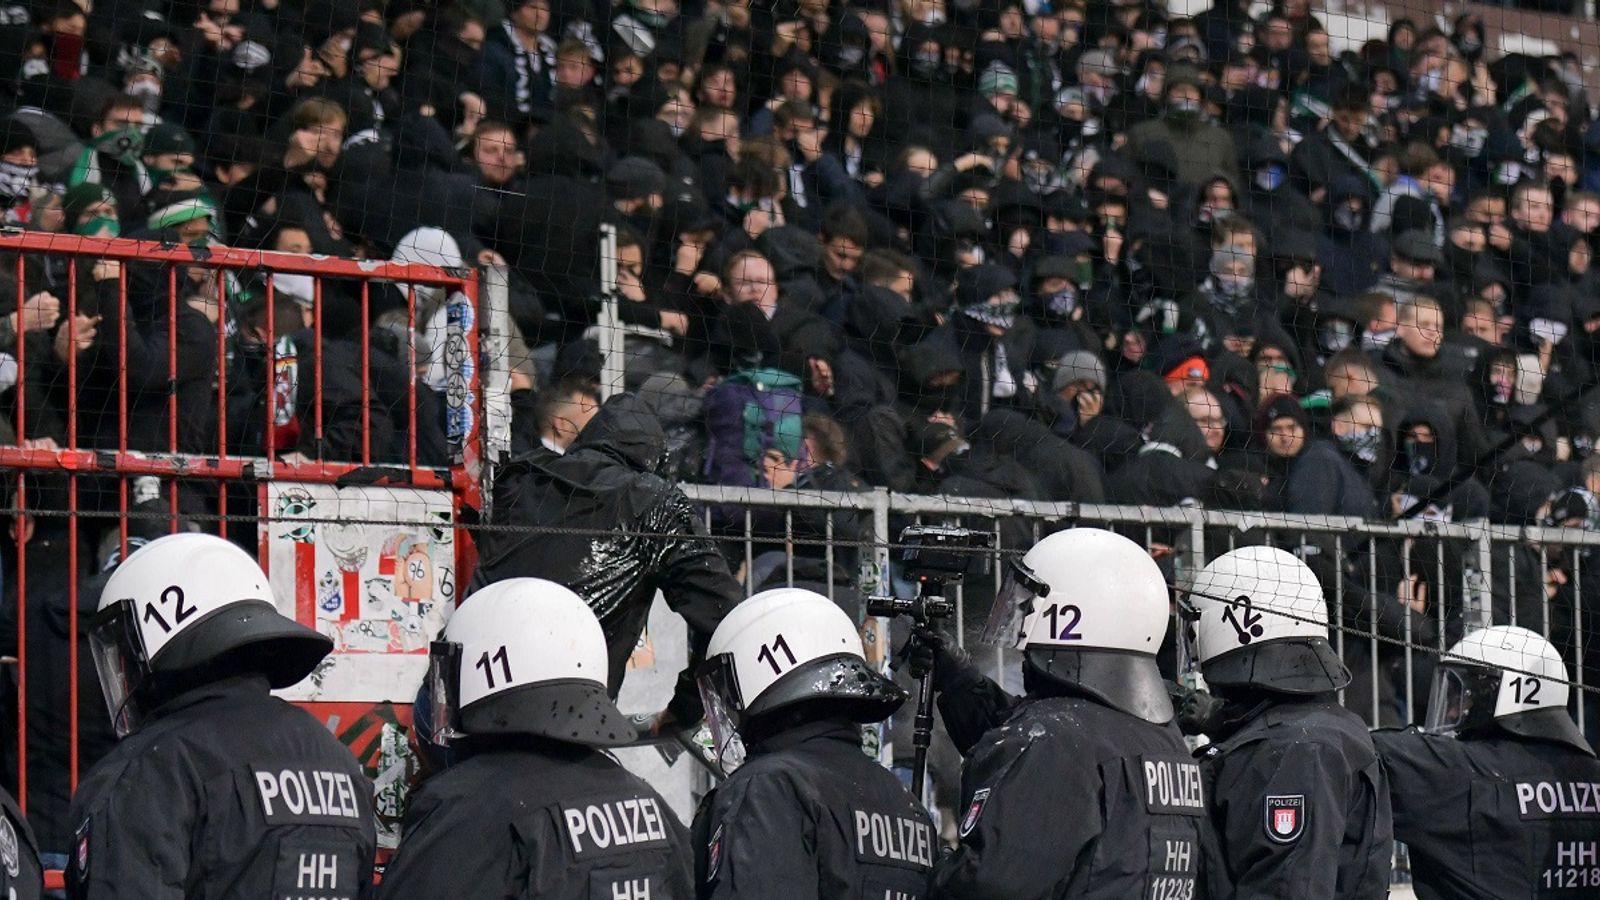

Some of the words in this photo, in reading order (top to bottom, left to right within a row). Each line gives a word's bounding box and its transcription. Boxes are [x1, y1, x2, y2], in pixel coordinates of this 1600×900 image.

[409, 559, 425, 580] 96
[143, 585, 197, 634] 12
[1042, 604, 1083, 641] 12
[1221, 594, 1264, 645] 12
[476, 646, 513, 688] 11
[757, 634, 798, 676] 11
[1509, 677, 1541, 704] 12
[255, 769, 360, 818] POLIZEI
[1145, 760, 1205, 808] POLIZEI
[1268, 798, 1301, 807] POLIZEI
[564, 797, 667, 853] POLIZEI
[854, 810, 934, 867] POLIZEI
[297, 853, 337, 889] HH
[1165, 840, 1191, 872] HH
[1557, 841, 1597, 866] HH
[611, 878, 650, 900] HH
